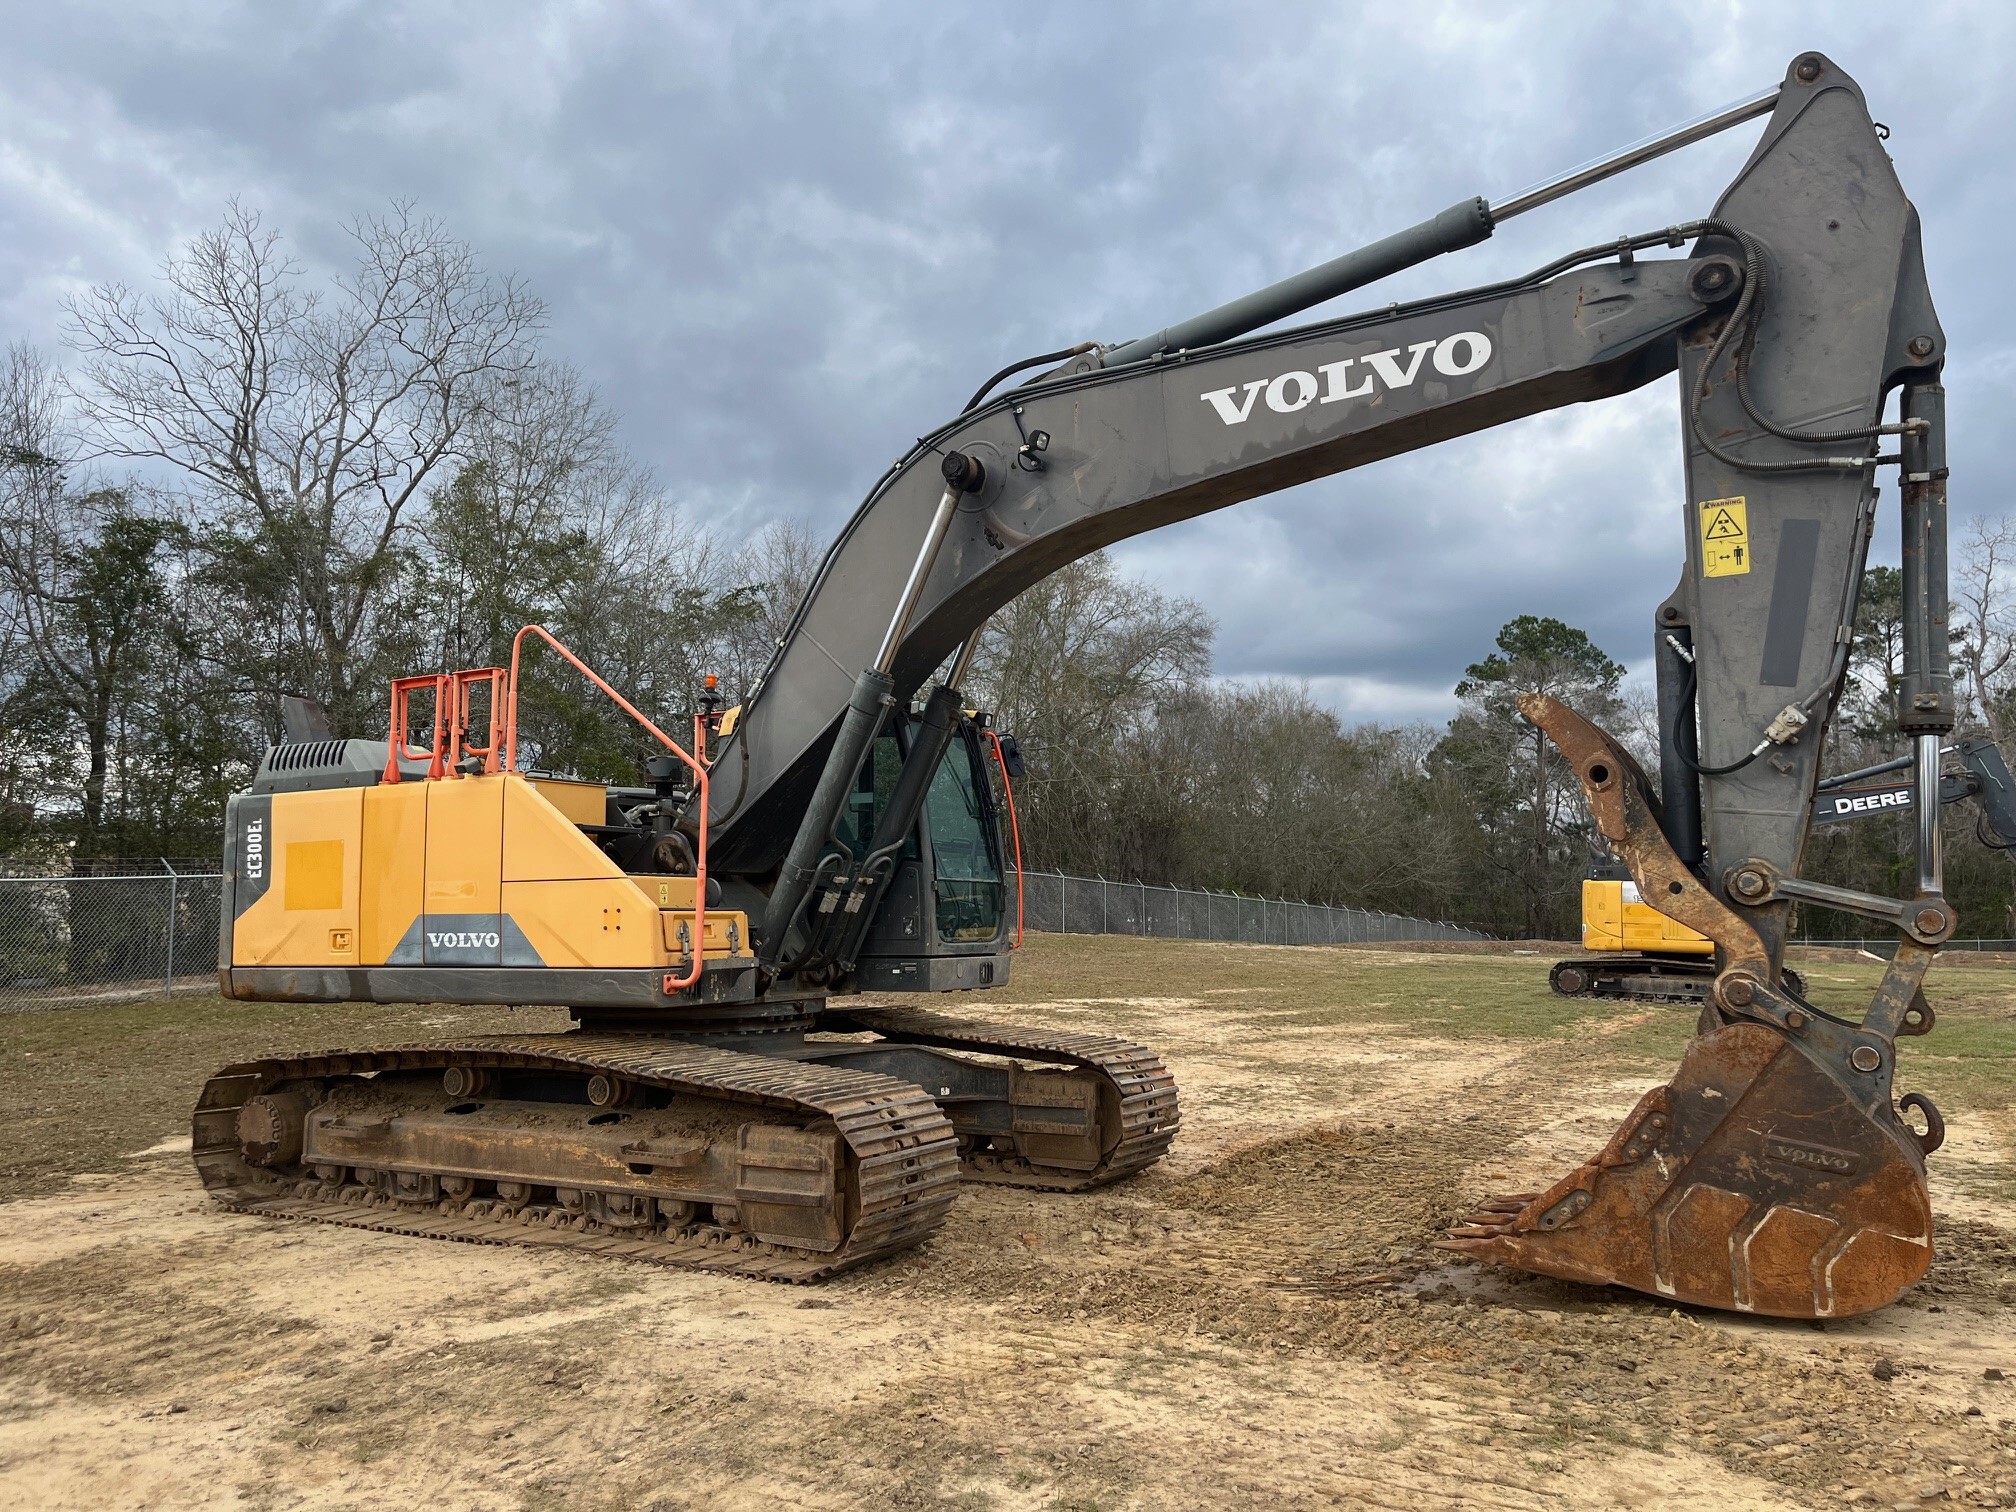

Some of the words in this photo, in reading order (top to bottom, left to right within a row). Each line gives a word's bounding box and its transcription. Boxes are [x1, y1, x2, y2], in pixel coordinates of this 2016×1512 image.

[1200, 331, 1491, 425] VOLVO
[1710, 499, 1742, 507] WARNING
[1835, 790, 1910, 814] DEERE
[247, 818, 262, 878] EC300EL
[427, 933, 500, 947] VOLVO
[1775, 1145, 1849, 1168] VOLVO
